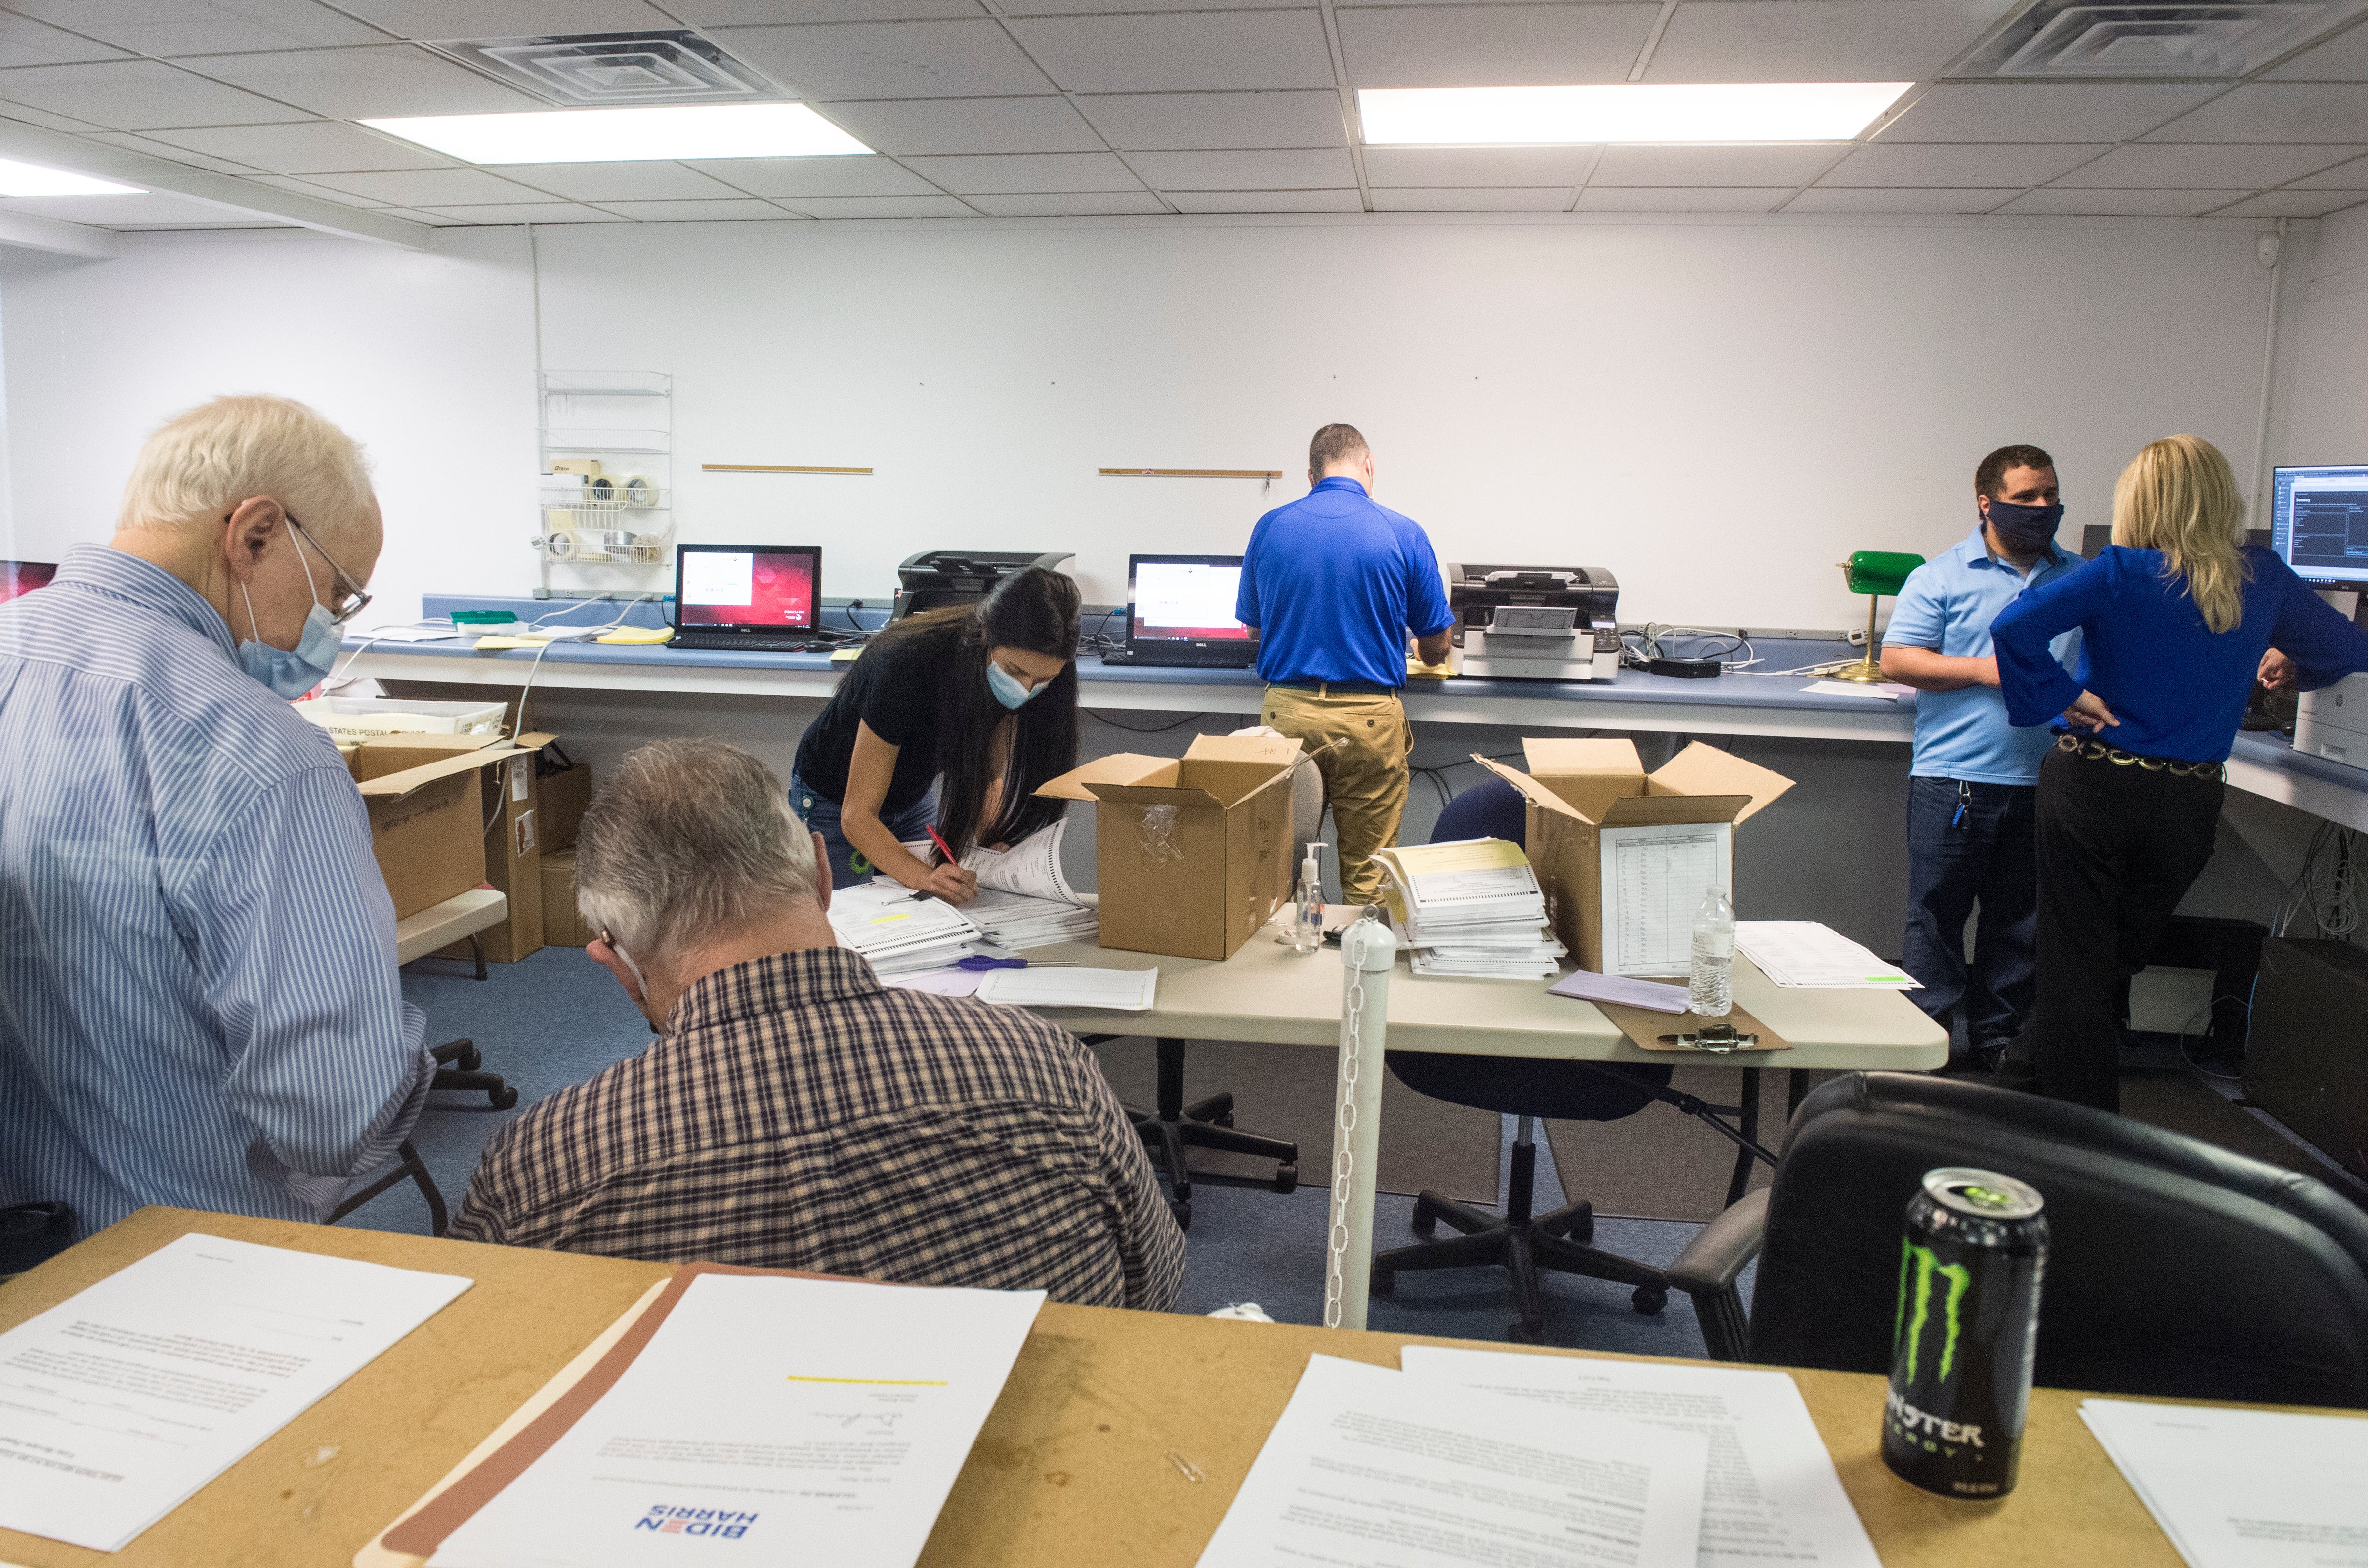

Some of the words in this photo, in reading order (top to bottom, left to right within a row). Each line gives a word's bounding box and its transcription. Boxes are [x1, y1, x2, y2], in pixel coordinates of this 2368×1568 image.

[329, 727, 357, 735] STATES
[648, 1503, 758, 1524] HARRIS
[635, 1517, 748, 1540] BIDEN
